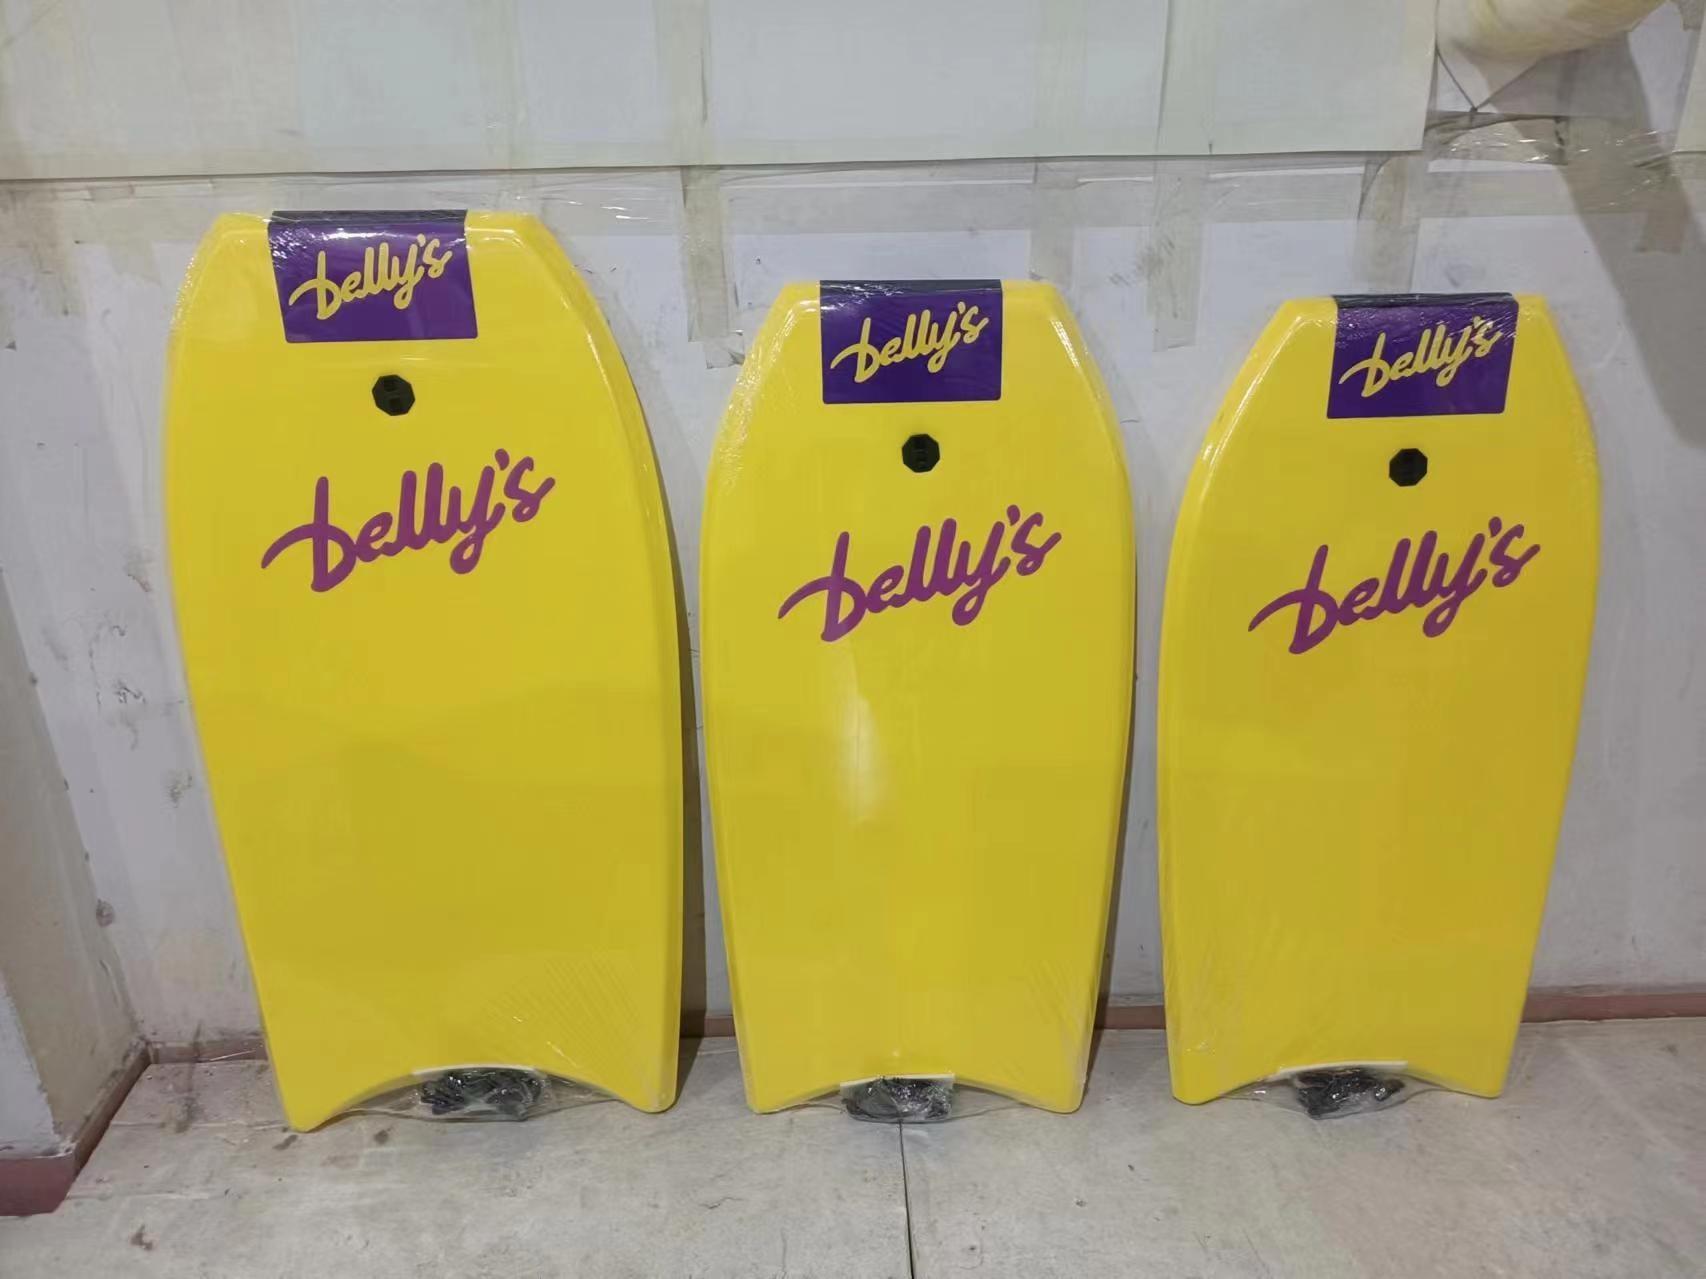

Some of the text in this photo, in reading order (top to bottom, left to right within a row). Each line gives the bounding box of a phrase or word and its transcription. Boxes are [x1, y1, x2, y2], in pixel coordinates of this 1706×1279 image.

[288, 233, 453, 320] belly's
[829, 301, 989, 383] belly's
[1338, 315, 1503, 398] belly's
[261, 448, 556, 593] belly's
[777, 504, 1062, 642] belly's
[1247, 516, 1541, 655] belly's
